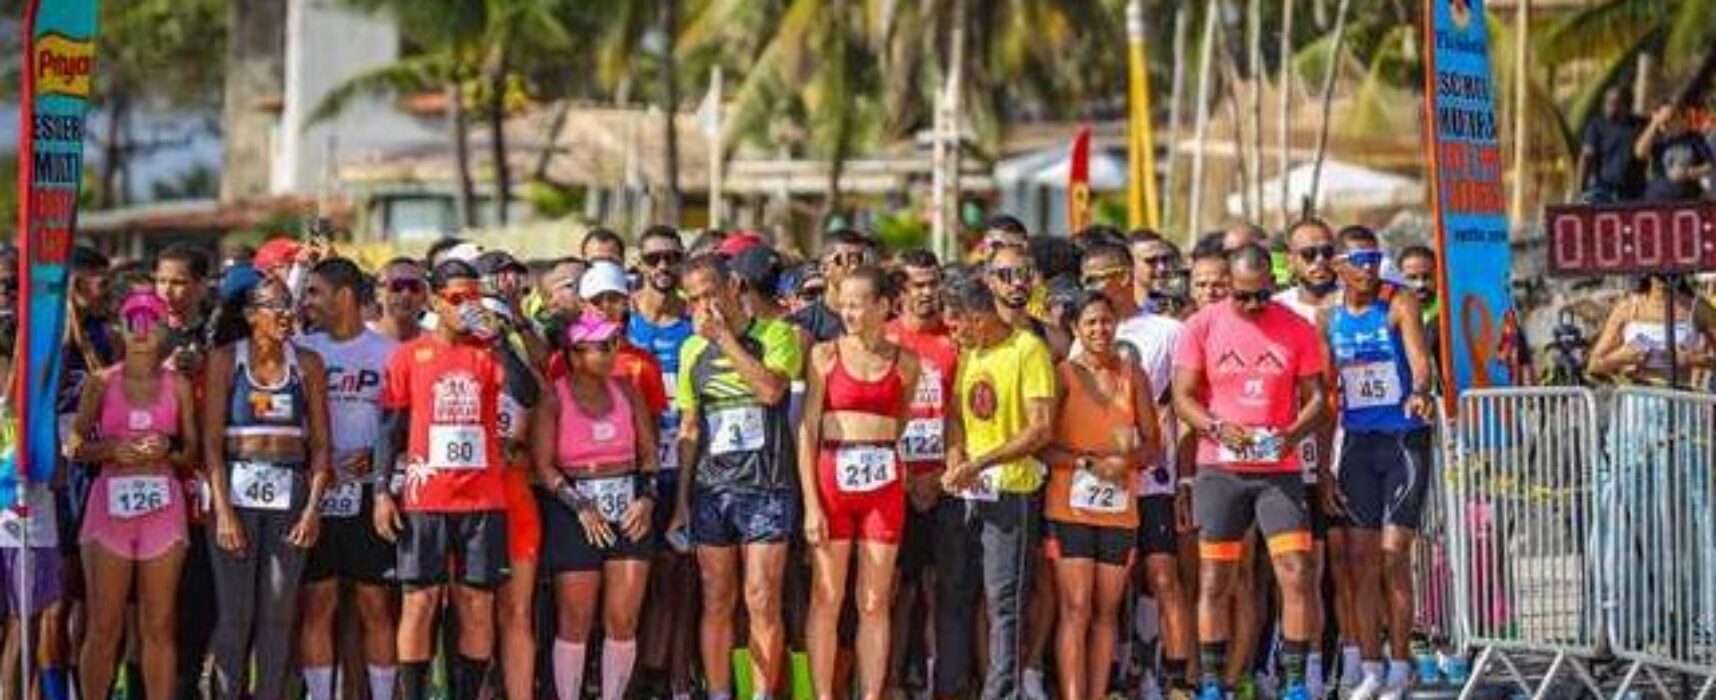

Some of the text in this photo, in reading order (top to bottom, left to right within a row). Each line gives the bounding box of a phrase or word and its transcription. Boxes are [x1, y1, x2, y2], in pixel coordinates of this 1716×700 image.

[1360, 380, 1386, 398] 45
[446, 442, 473, 462] 80
[902, 436, 943, 453] 122
[845, 463, 888, 486] 214
[119, 491, 162, 512] 126
[246, 482, 275, 503] 46
[1087, 487, 1115, 507] 72
